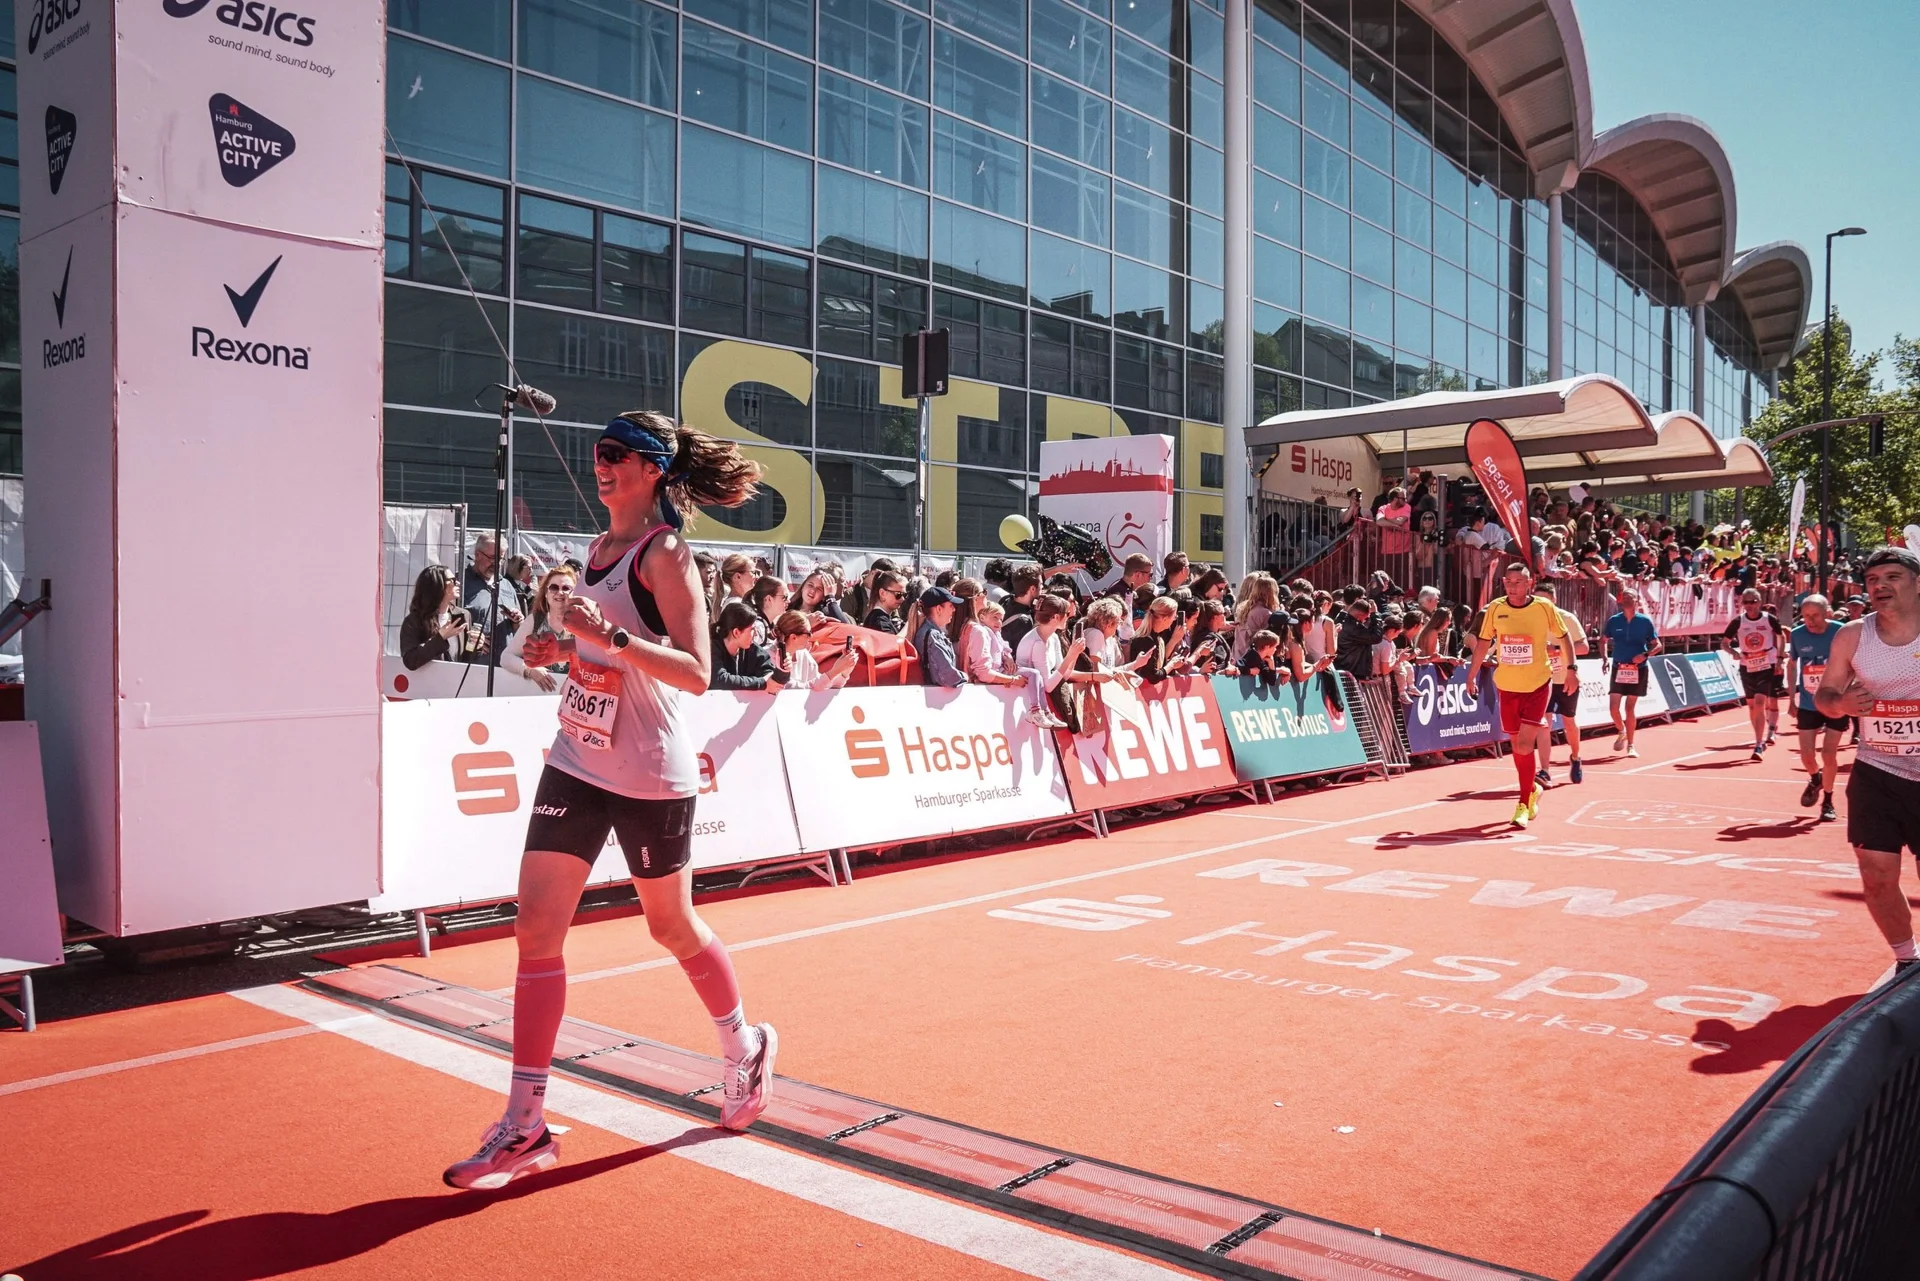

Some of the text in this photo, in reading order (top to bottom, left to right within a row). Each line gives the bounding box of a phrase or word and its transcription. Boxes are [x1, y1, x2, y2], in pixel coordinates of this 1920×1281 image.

[216, 0, 316, 47] asics
[208, 34, 336, 78] sound mind, sound body
[215, 114, 253, 131] Hamburg
[50, 131, 72, 156] ACTIVE
[220, 130, 282, 157] ACTIVE
[222, 149, 262, 170] CITY
[51, 154, 65, 174] CITY
[43, 334, 86, 369] Rexona
[191, 326, 309, 370] Rexona
[1312, 448, 1352, 487] Haspa
[1230, 707, 1329, 743] REWE Bonus
[1887, 704, 1919, 714] Haspa
[1440, 725, 1454, 738] sound
[1466, 722, 1480, 733] sound
[1479, 721, 1492, 734] body
[898, 726, 1014, 781] Haspa
[914, 785, 1022, 808] Hamburger Sparkasse
[640, 846, 651, 868] FUSION
[1511, 841, 1859, 879] asics
[1195, 858, 1840, 939] REWE
[1176, 920, 1782, 1024] Haspa
[1112, 953, 1732, 1053] Hamburger Sparkasse
